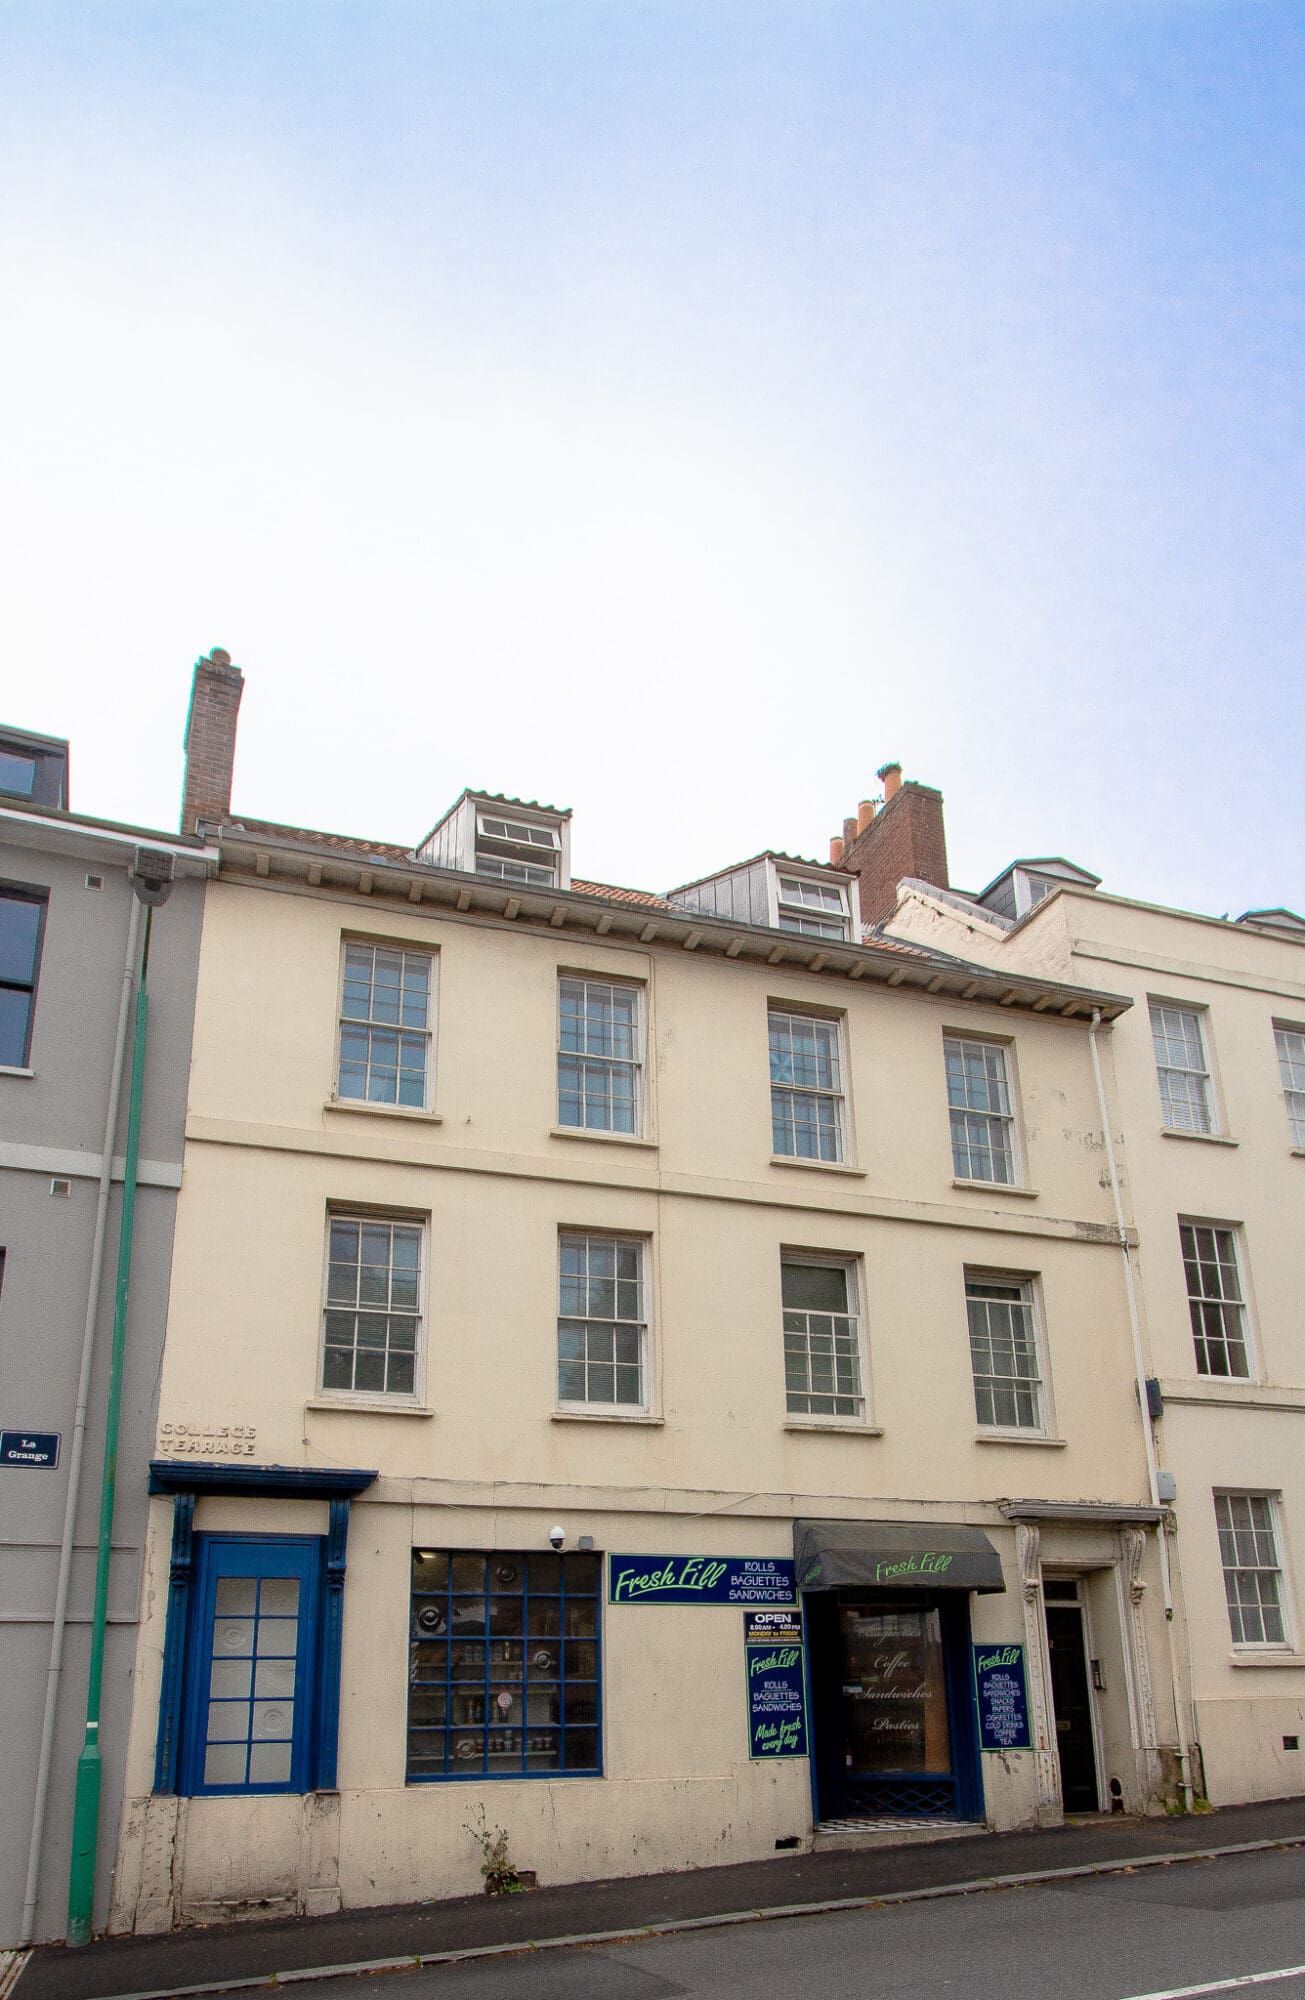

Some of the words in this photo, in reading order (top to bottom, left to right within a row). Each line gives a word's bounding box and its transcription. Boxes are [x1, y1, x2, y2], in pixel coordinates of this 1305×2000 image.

[21, 1439, 36, 1449] La
[160, 1440, 255, 1456] TERRACE
[8, 1450, 49, 1461] Grange
[744, 1562, 775, 1572] ROLLS
[876, 1556, 917, 1582] Fresh
[920, 1552, 953, 1571] Fill
[615, 1561, 675, 1600] Fresh
[679, 1558, 727, 1588] Fill
[730, 1576, 789, 1587] BAGUETTES
[728, 1589, 792, 1601] SANDWICHES
[754, 1614, 792, 1623] OPEN
[750, 1651, 778, 1677] Fresh
[778, 1648, 800, 1667] Fill
[874, 1651, 911, 1678] Coffee
[978, 1650, 1001, 1674] Fresh
[1001, 1647, 1020, 1664] Fill
[991, 1673, 1010, 1681] ROLLS
[764, 1681, 788, 1689] ROLLS
[856, 1680, 933, 1700] Sandwiches
[983, 1681, 1019, 1689] BAGUETTES
[753, 1692, 800, 1701] BAGUETTES
[983, 1689, 1021, 1697] SANDWICHES
[990, 1697, 1015, 1705] SNACKS
[752, 1703, 802, 1713] SANDWICHES
[992, 1705, 1015, 1713] PAPERS
[755, 1723, 778, 1742] Made
[780, 1716, 801, 1738] fresh
[872, 1717, 919, 1731] Pasties
[985, 1722, 1001, 1730] COLD
[1002, 1721, 1024, 1729] DRINKS
[784, 1731, 799, 1749] day
